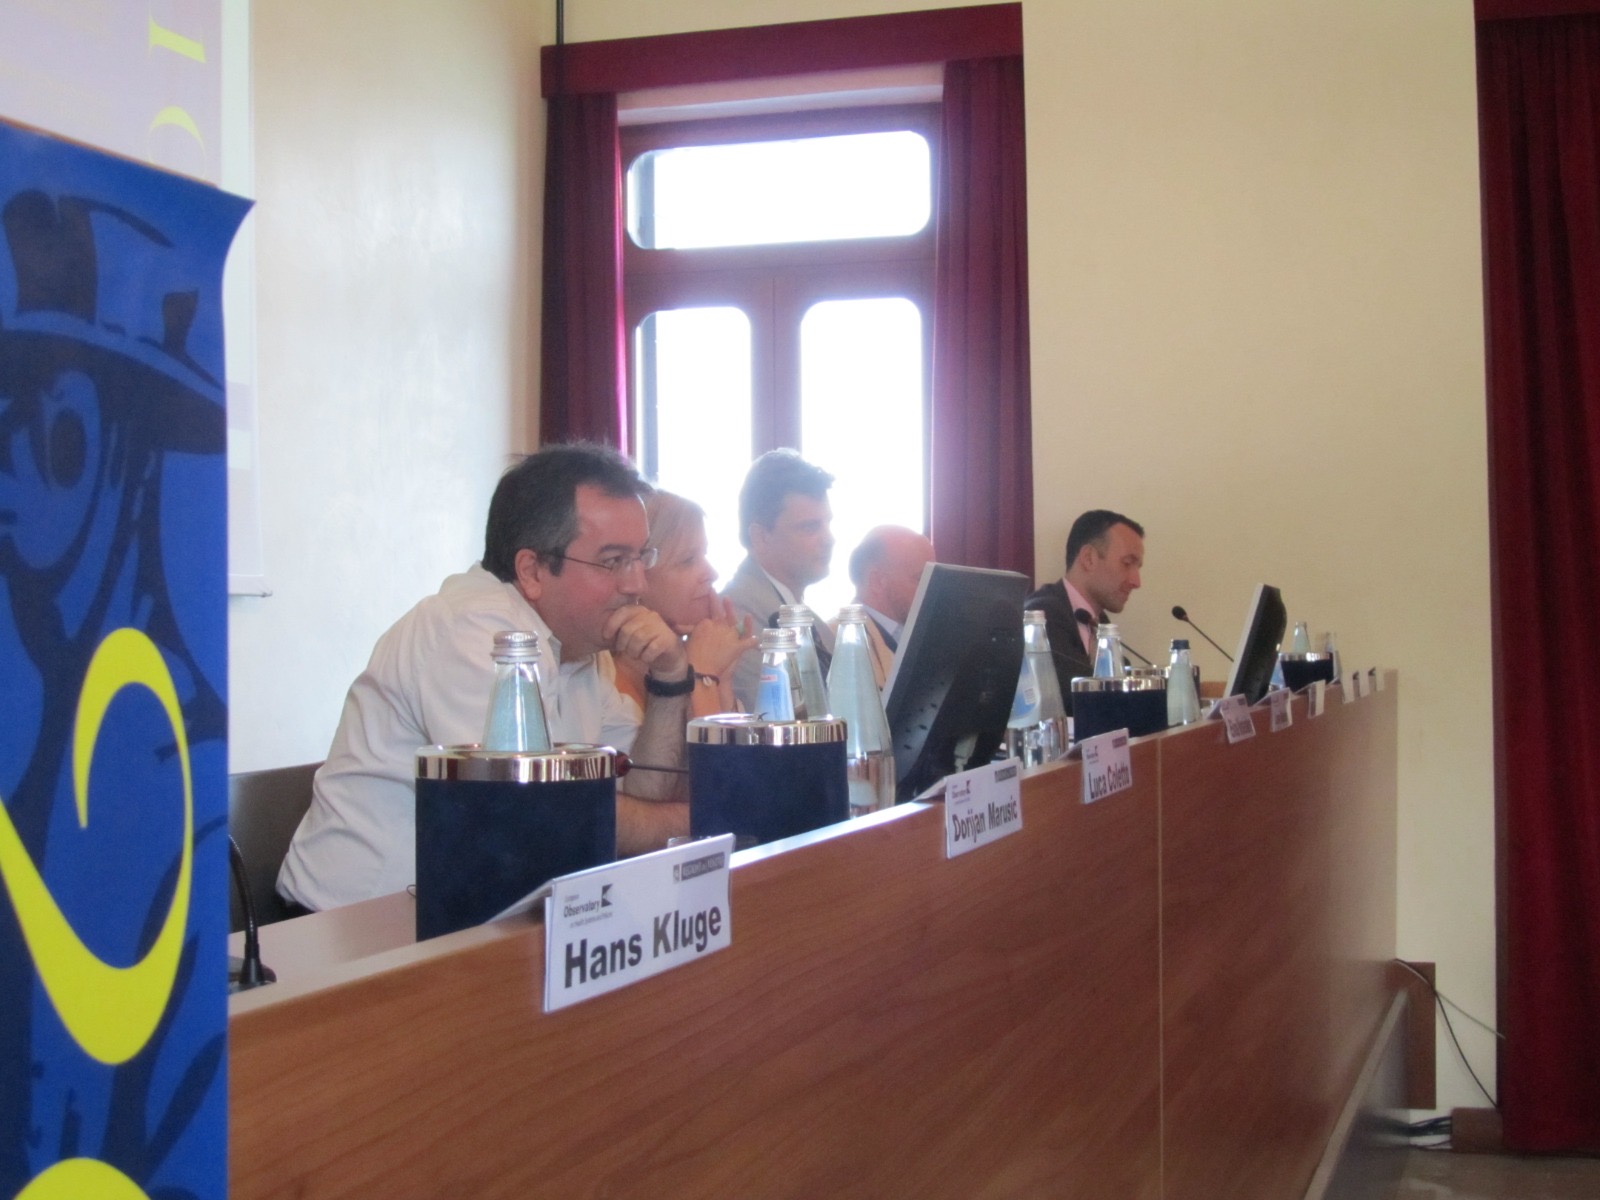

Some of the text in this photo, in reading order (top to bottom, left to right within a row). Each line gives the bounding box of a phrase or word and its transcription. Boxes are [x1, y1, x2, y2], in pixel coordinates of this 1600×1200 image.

[1089, 771, 1107, 799] Luca
[952, 796, 1018, 843] Dorijan Marusic
[563, 900, 601, 918] Observatory
[565, 906, 722, 988] Hans Kluge
